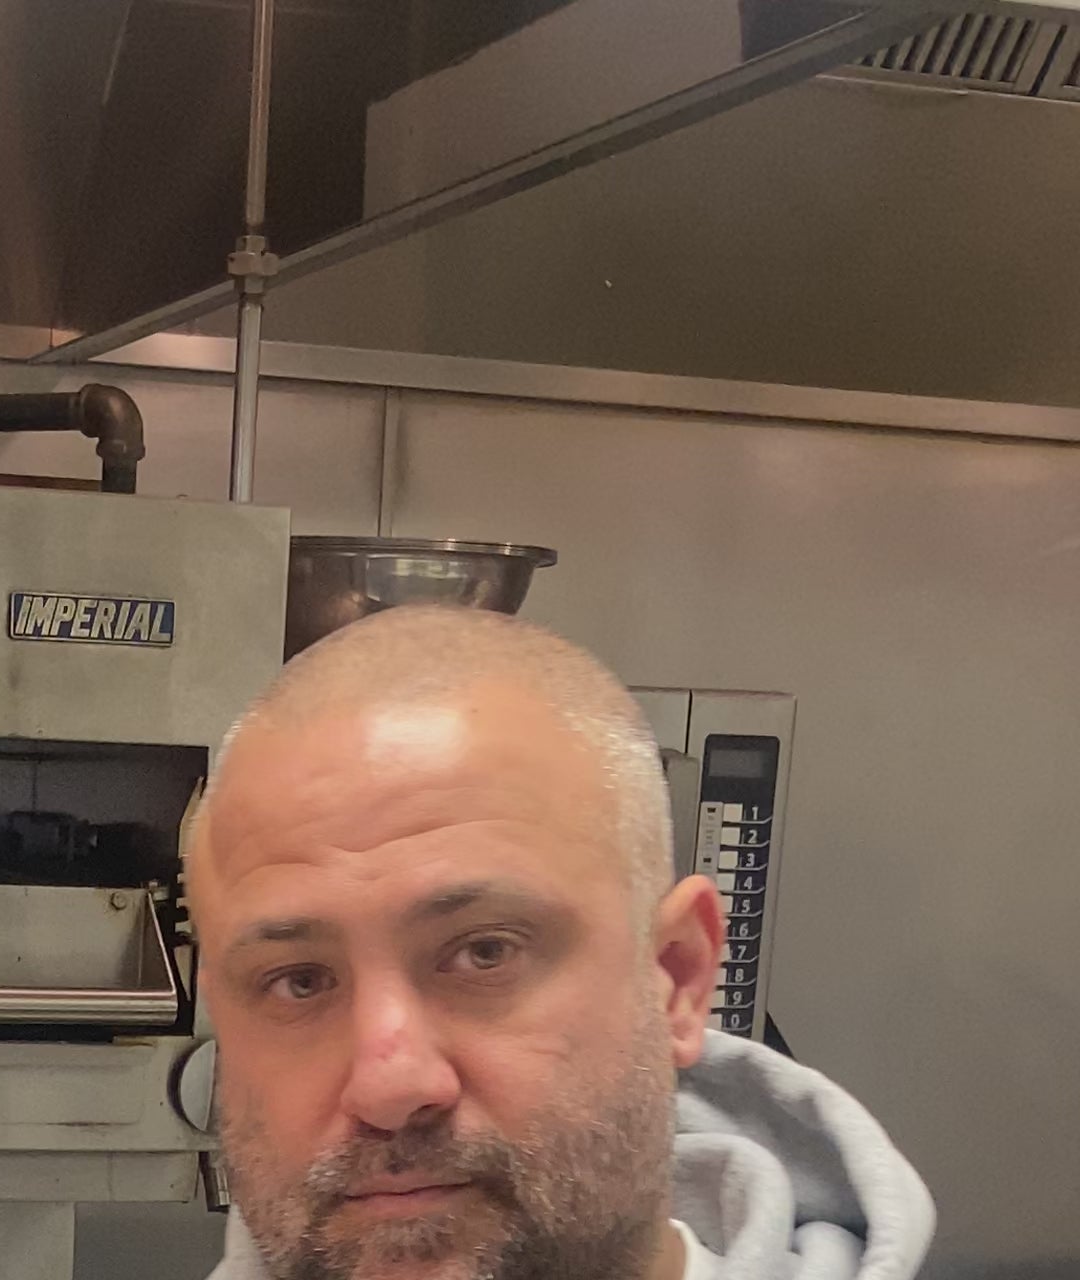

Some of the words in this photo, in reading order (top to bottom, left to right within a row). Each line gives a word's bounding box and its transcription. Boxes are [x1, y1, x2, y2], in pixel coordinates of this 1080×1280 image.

[15, 596, 171, 643] IMPERIAL
[751, 805, 759, 821] 1
[747, 829, 758, 844] 2
[745, 852, 756, 867] 3
[743, 876, 753, 890] 4
[741, 899, 751, 914] 5
[739, 922, 749, 937] 6
[737, 945, 747, 959] 7
[734, 968, 744, 982] 8
[732, 991, 742, 1005] 9
[730, 1014, 740, 1028] 0
